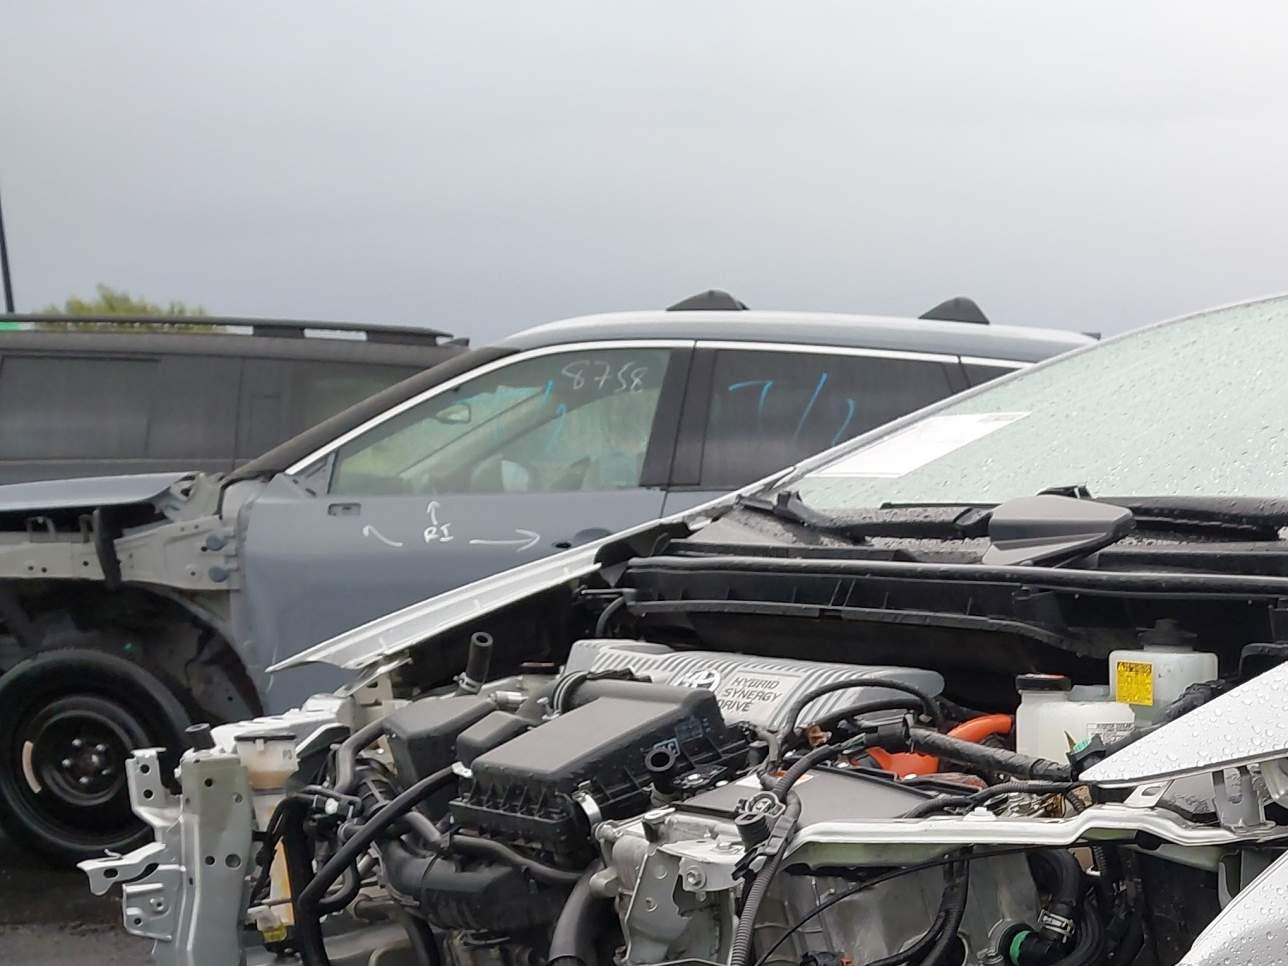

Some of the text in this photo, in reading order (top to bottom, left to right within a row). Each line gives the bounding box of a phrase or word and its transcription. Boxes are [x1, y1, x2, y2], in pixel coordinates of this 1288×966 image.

[561, 360, 648, 393] 8758
[424, 524, 454, 543] RI
[731, 677, 780, 689] HYBRID
[722, 688, 783, 702] SYNERGY
